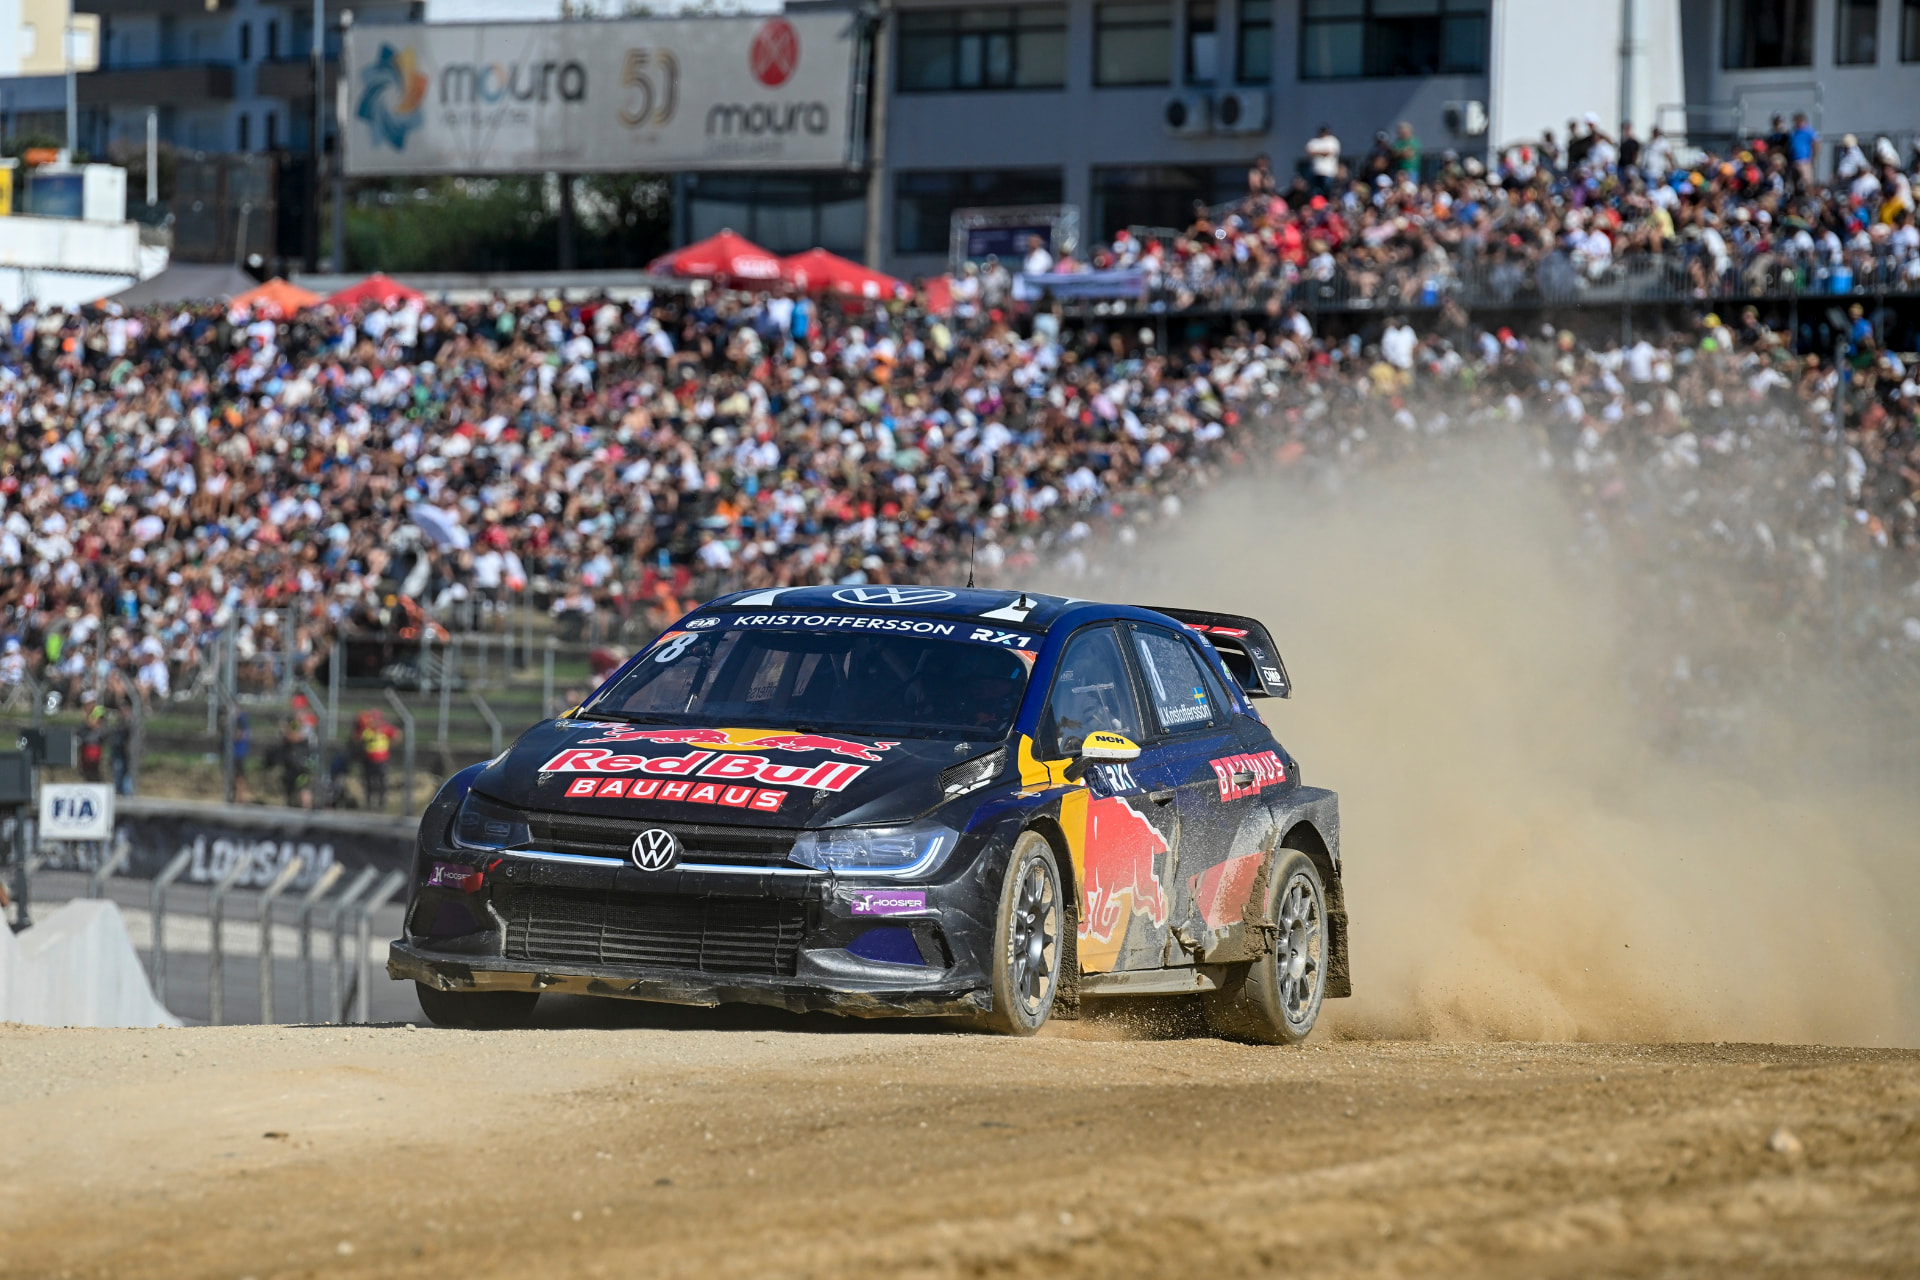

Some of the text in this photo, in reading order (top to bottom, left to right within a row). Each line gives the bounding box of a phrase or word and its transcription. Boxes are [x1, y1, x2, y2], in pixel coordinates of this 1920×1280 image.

[440, 57, 587, 104] moura
[617, 47, 680, 129] 50
[705, 100, 831, 136] moura
[686, 617, 720, 629] FIA
[733, 615, 956, 635] KRISTOFFERSSON
[969, 627, 1032, 648] RX1
[654, 633, 699, 663] 8
[1140, 639, 1167, 702] 8
[1095, 735, 1125, 745] NCH
[538, 748, 870, 792] Red Bull
[1104, 763, 1138, 792] RX1
[52, 798, 94, 818] FIA
[569, 778, 782, 811] BAUHAUS
[872, 899, 923, 907] HOOSIER
